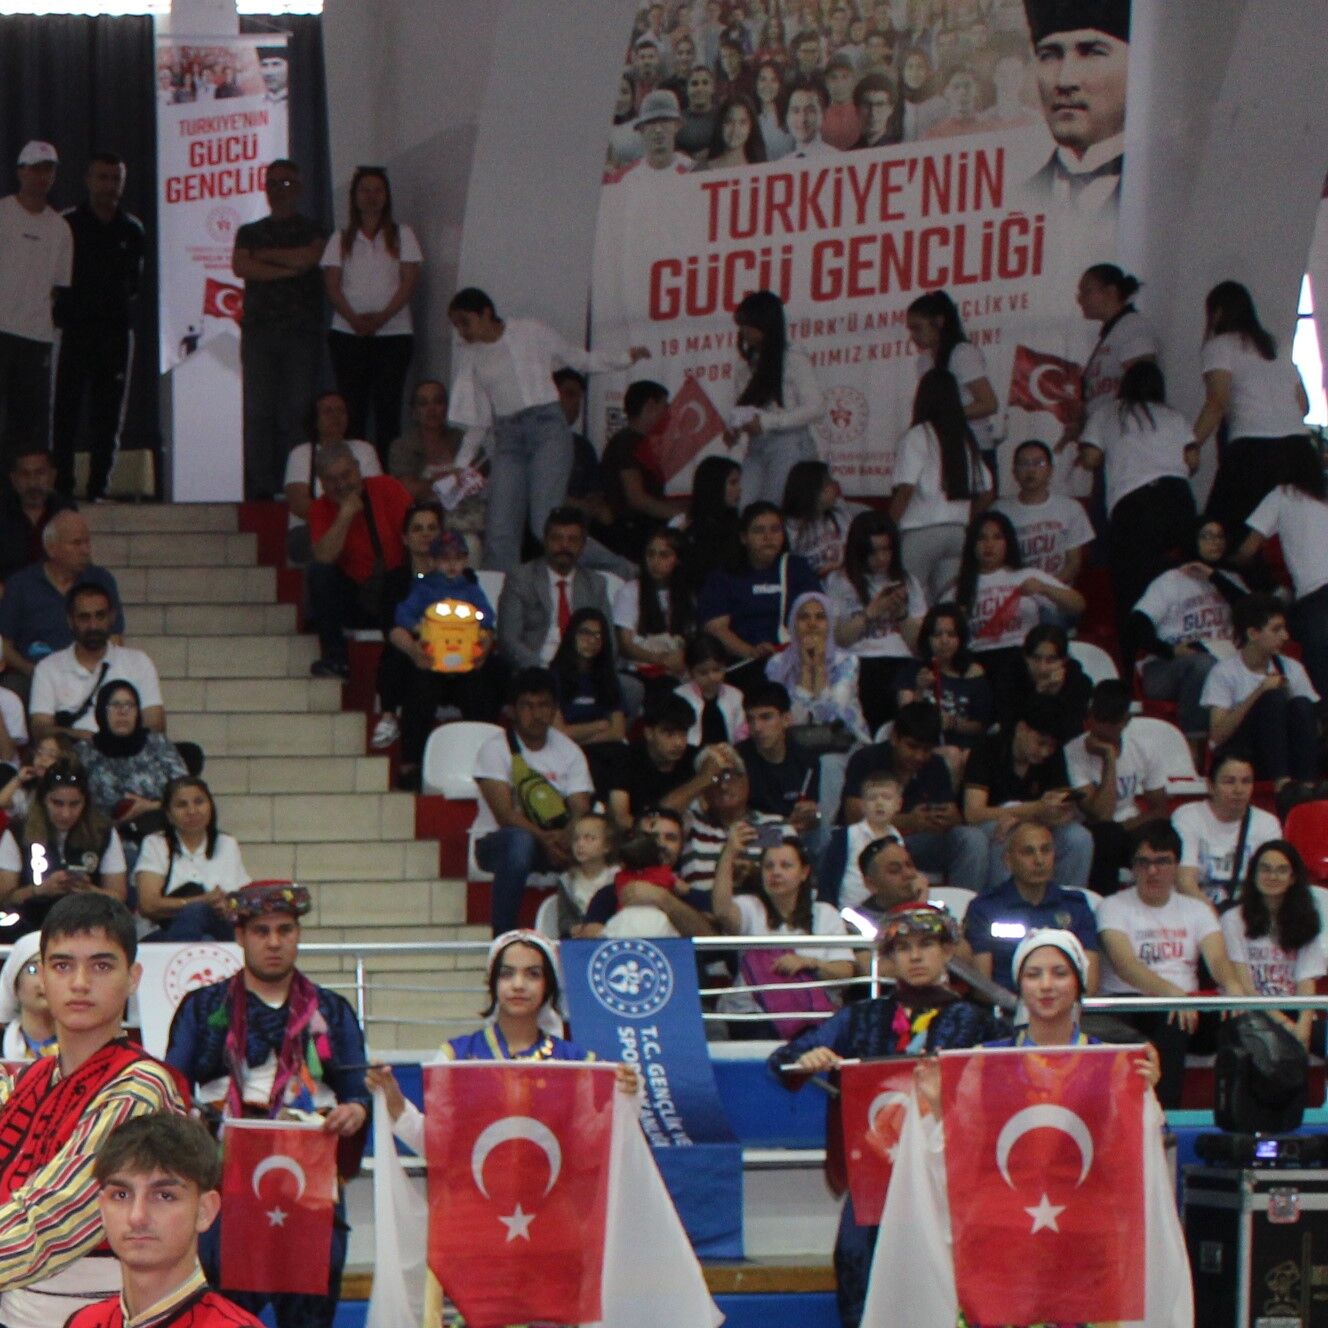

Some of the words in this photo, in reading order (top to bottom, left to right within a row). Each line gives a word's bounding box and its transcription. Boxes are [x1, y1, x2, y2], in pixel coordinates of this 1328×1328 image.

[190, 134, 258, 168] GÜCÜ
[701, 148, 1004, 242] TÜRKİYE'NİN
[649, 245, 793, 321] GÜCÜ
[685, 332, 734, 352] MAYI
[789, 311, 859, 339] TÜRK'Ü
[864, 310, 906, 330] ANM
[867, 341, 913, 361] KUTL
[640, 1025, 661, 1060] T.C.
